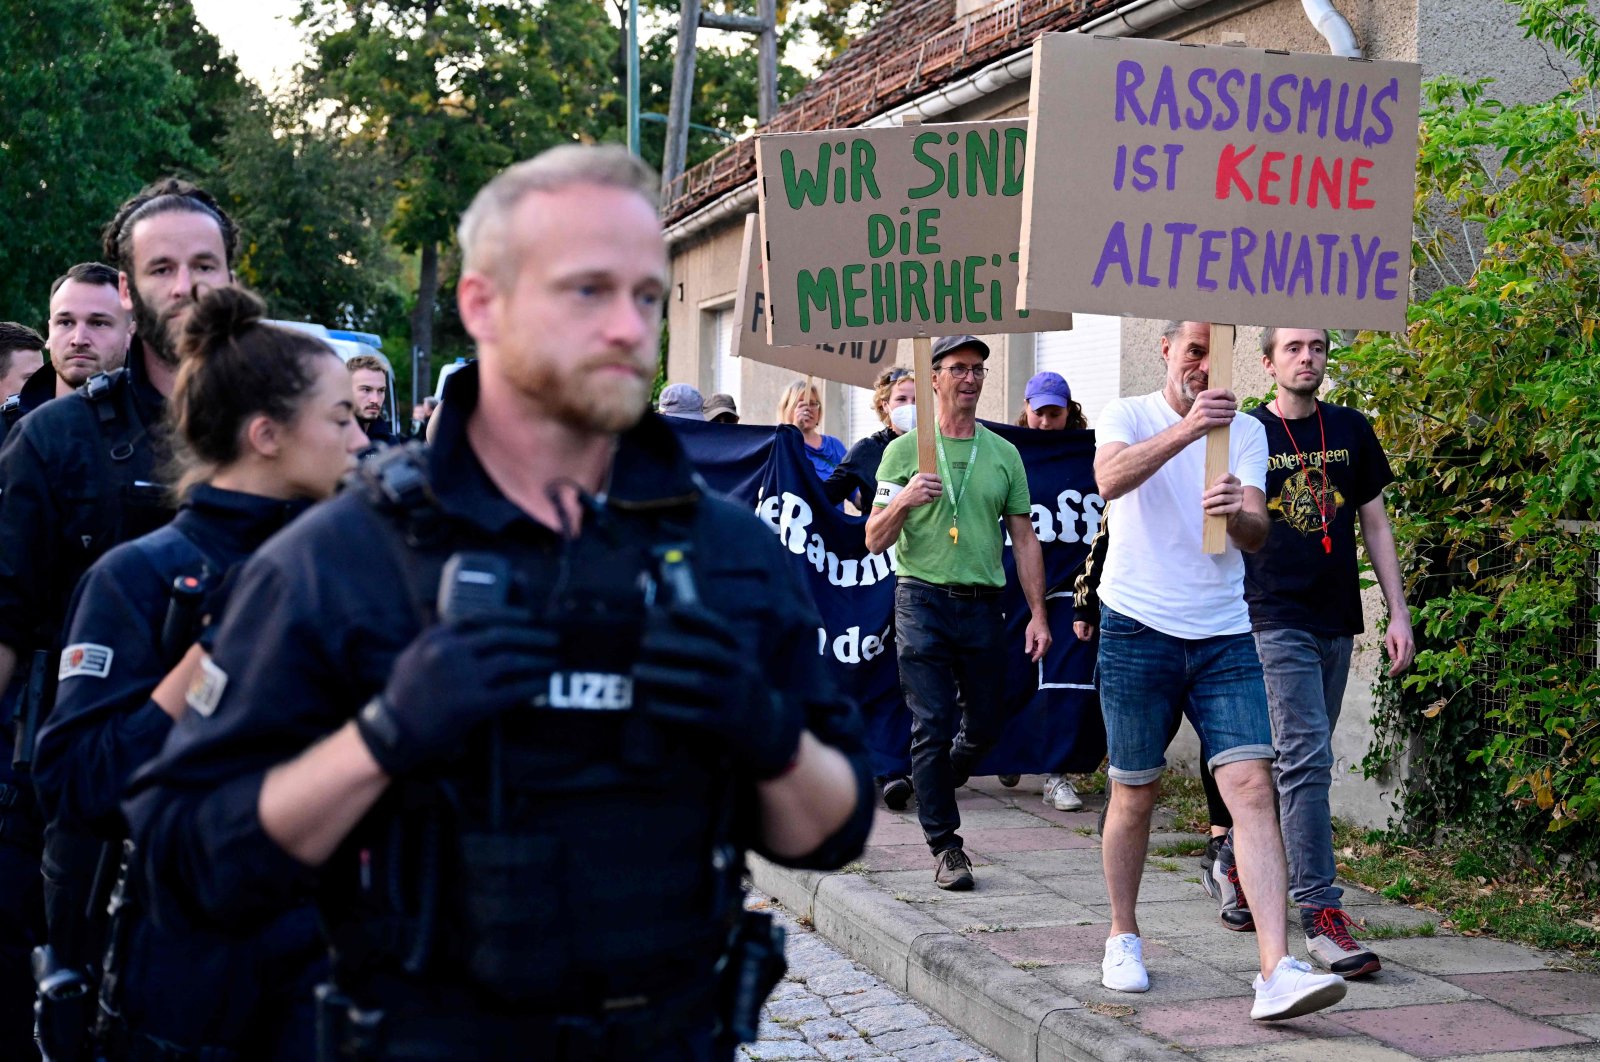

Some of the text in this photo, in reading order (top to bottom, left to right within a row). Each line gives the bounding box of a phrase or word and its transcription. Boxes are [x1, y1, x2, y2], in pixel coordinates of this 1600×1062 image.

[1115, 60, 1399, 149] RASSISMUS
[1113, 143, 1376, 211] IST KEINE
